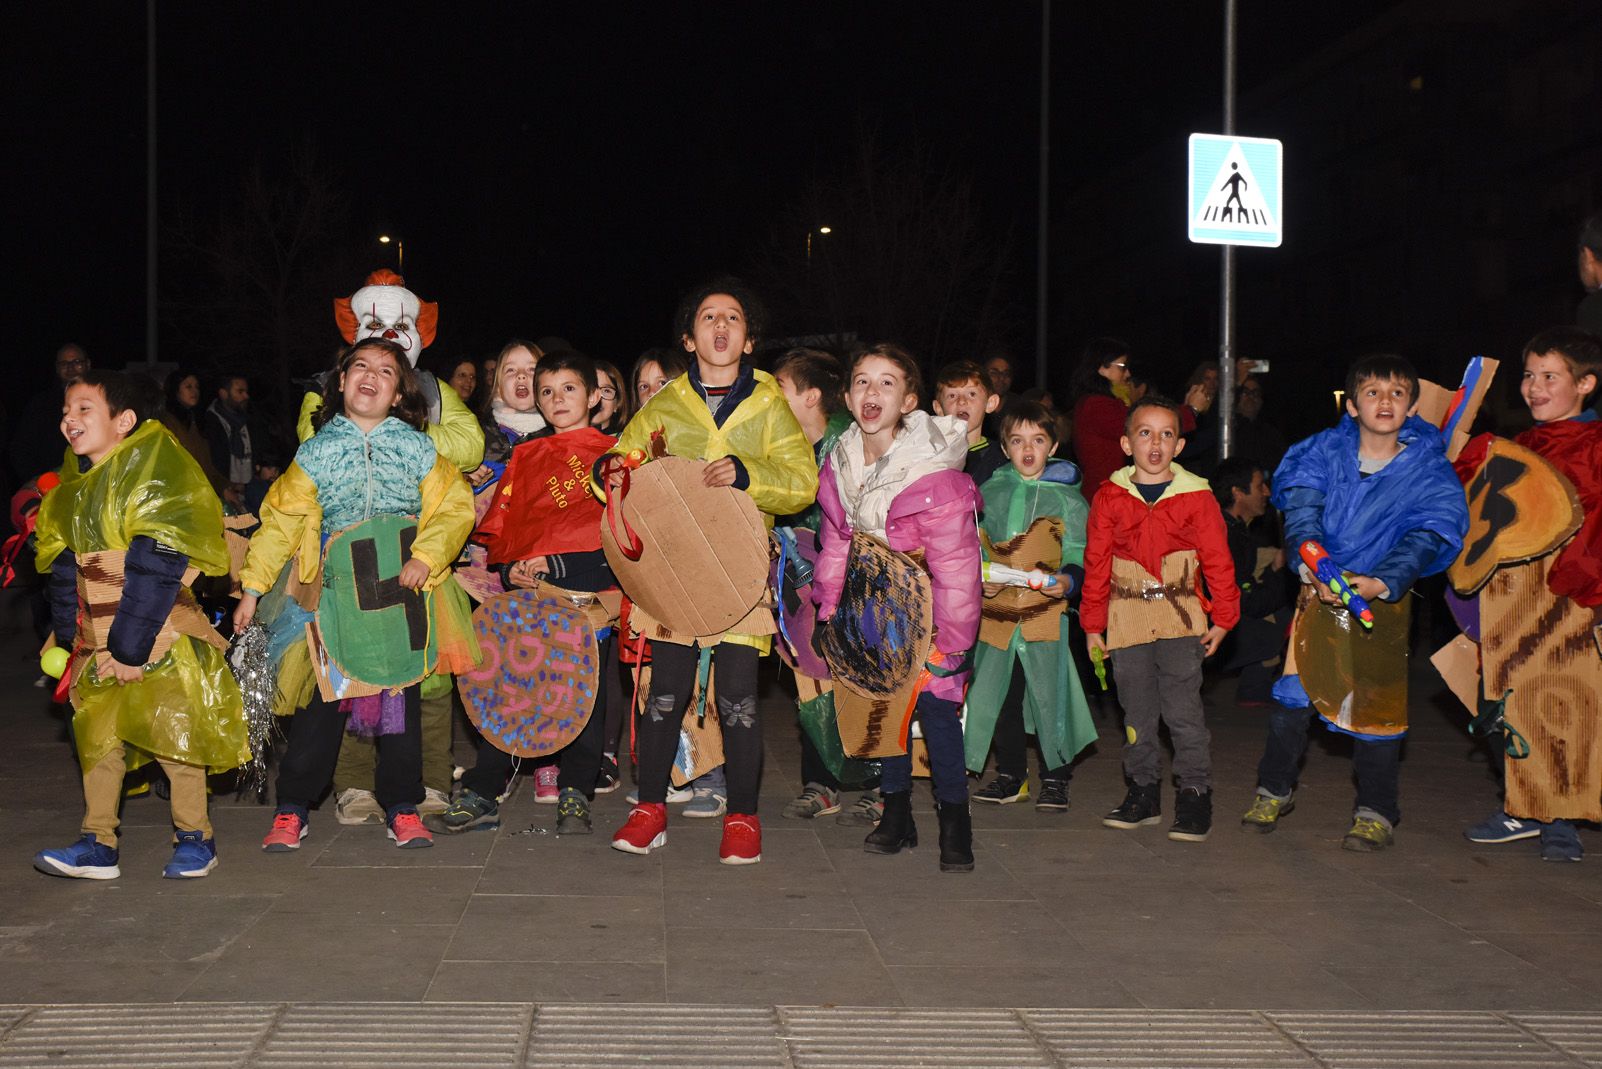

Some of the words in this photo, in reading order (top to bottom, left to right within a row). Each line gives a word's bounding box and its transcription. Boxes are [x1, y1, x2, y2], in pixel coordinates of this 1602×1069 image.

[546, 476, 568, 508] Pluto
[563, 479, 576, 491] &
[351, 525, 430, 651] 4
[1503, 818, 1523, 832] N
